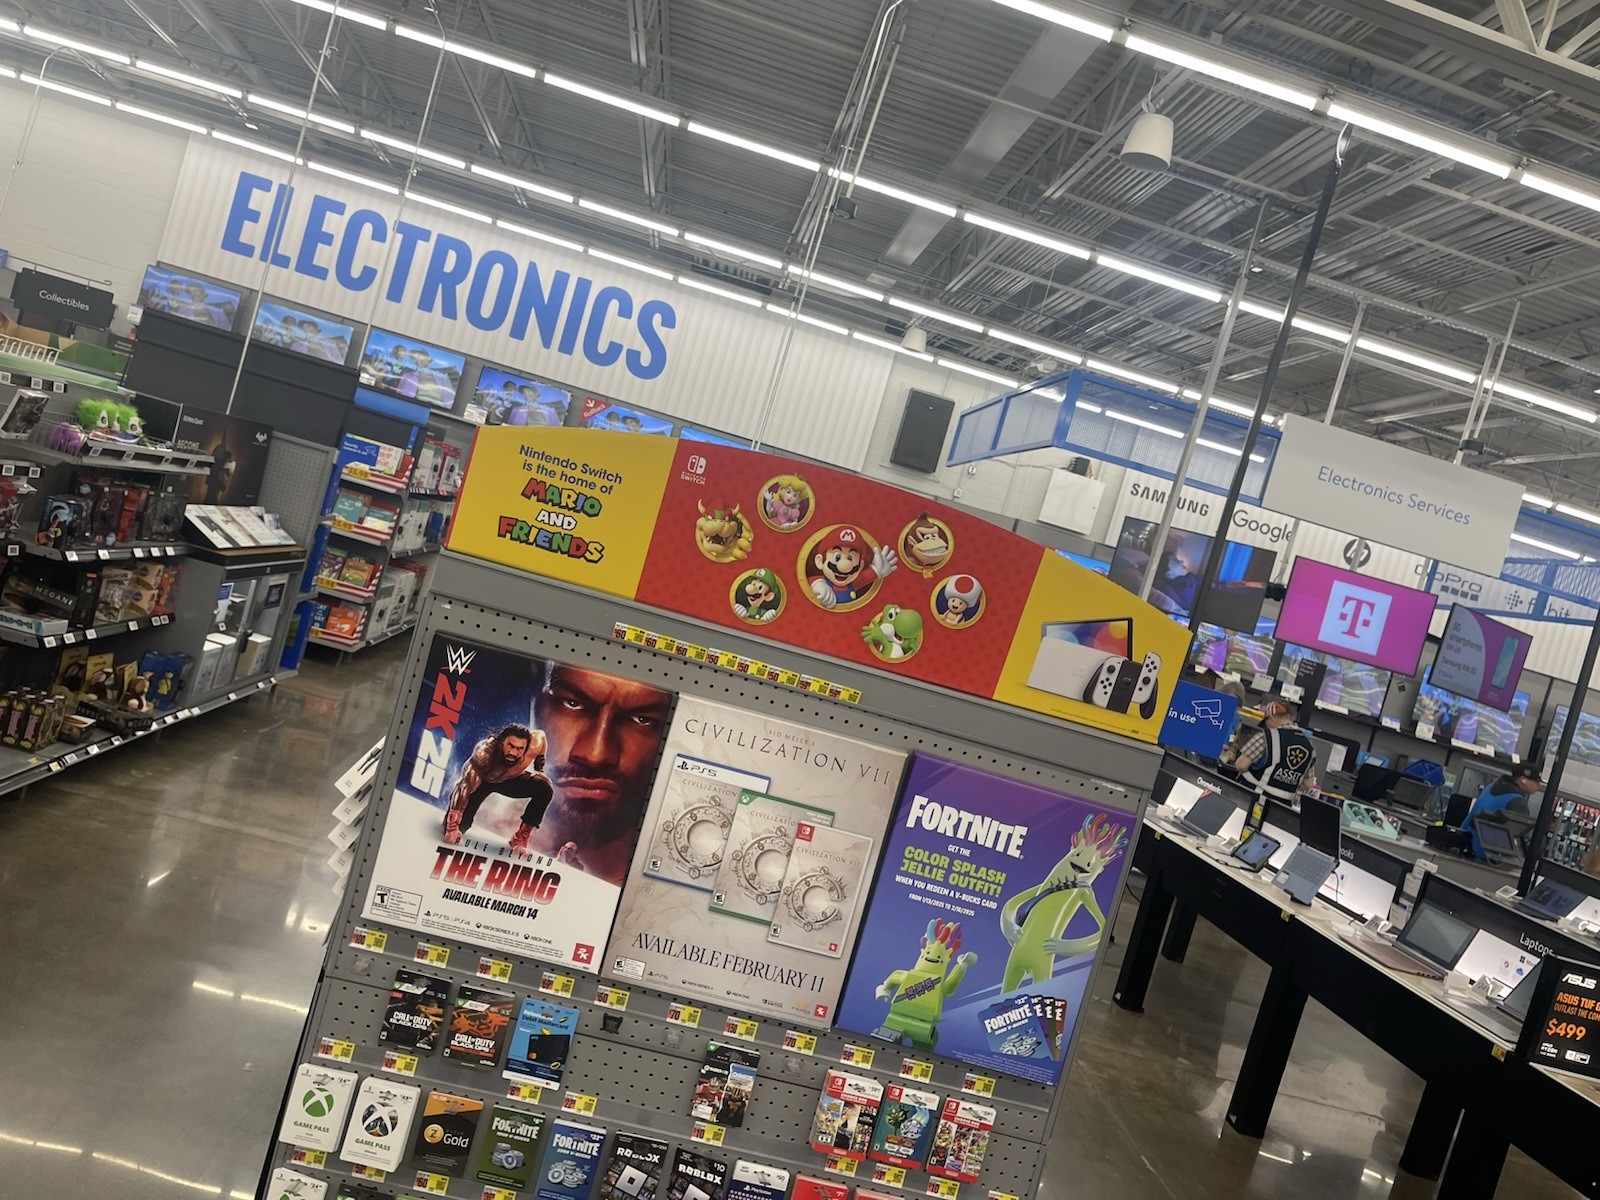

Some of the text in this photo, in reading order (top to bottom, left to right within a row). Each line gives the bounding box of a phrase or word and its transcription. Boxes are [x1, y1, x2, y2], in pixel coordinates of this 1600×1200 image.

[220, 171, 677, 380] ELECTRONICS
[39, 289, 90, 312] Collectibles
[519, 444, 622, 484] Nintendo Switch
[522, 460, 613, 495] is the home of
[680, 475, 706, 486] SWITCH
[521, 477, 602, 517] MARIO
[1131, 483, 1210, 517] SAMUNG
[1317, 465, 1471, 526] Electronics Services
[535, 509, 577, 531] AND
[497, 515, 604, 564] FRIENDS
[1340, 594, 1376, 639] T
[1168, 707, 1197, 724] in use
[409, 672, 469, 799] 2K25
[685, 718, 891, 786] CIVILIZATION VII
[690, 766, 717, 778] PS5
[682, 778, 737, 798] CIVILIZATION
[750, 810, 799, 827] CIVILIZATIO
[905, 794, 1028, 858] FORTNITE
[454, 837, 553, 867] RULE BEYOND
[947, 844, 972, 857] GET THE
[430, 845, 562, 906] THE RING
[904, 846, 1007, 885] COLOR SPLASH
[900, 858, 1003, 898] JELLIE OUTFIT!
[377, 892, 388, 904] T
[895, 874, 998, 910] WHEN YOU REDEEM A V-BUCKS CARD
[908, 893, 922, 902] FROM
[442, 888, 539, 920] AVAILABLE MARCH 14
[631, 932, 825, 993] AVAILABLE FEBRUARY 11
[1562, 973, 1597, 990] ASUS
[1554, 1003, 1588, 1019] OUTLAST THE
[1556, 992, 1580, 1006] ASUS
[1580, 996, 1596, 1010] TUF
[389, 1017, 412, 1028] BLACK
[393, 1010, 432, 1027] CALL DUTY
[522, 1015, 569, 1030] Debit Mastercard
[667, 1009, 680, 1021] $70
[983, 1004, 1033, 1034] FORTNITE
[454, 1032, 495, 1049] CALL DUTY
[1546, 1018, 1587, 1041] $499
[450, 1040, 474, 1050] BLACK
[293, 1120, 330, 1134] GAME PASS
[491, 1116, 540, 1140] FORTNITE
[354, 1137, 391, 1151] GAME PASS
[443, 1133, 469, 1148] Gold
[552, 1133, 600, 1157] FORTNITE
[677, 1163, 723, 1186] ROBLOX
[713, 1162, 726, 1172] $10
[751, 1186, 772, 1196] PlayStation
